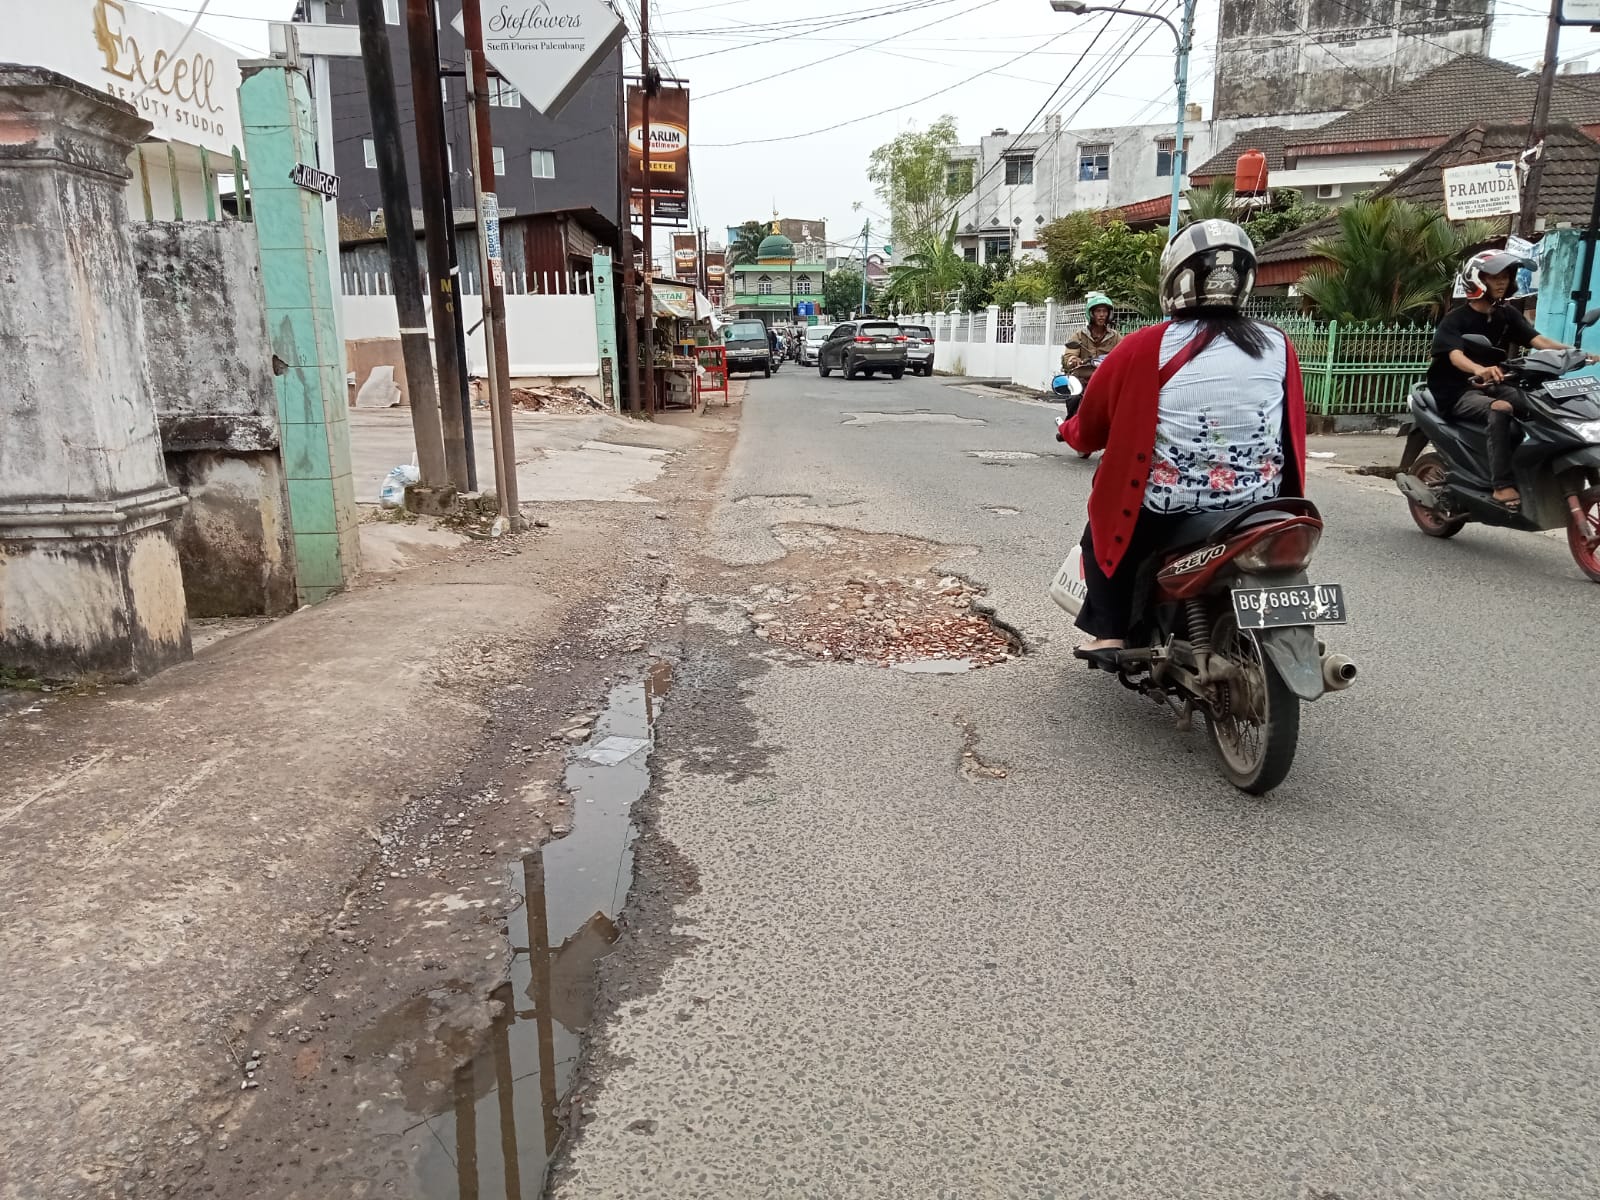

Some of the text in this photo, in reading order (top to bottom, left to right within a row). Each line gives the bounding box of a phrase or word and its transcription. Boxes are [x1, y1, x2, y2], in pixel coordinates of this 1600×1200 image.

[488, 4, 582, 39] Steflowers
[92, 0, 224, 113] Excell
[487, 41, 586, 52] Steffi Florist Palembang
[175, 108, 224, 136] STUDIO
[637, 129, 680, 143] DARUM
[1449, 179, 1516, 198] PRAMUDA
[485, 219, 493, 231] WC
[487, 234, 496, 258] SEDOT
[1174, 544, 1227, 575] REVO
[1238, 588, 1338, 610] BG 6863 UV
